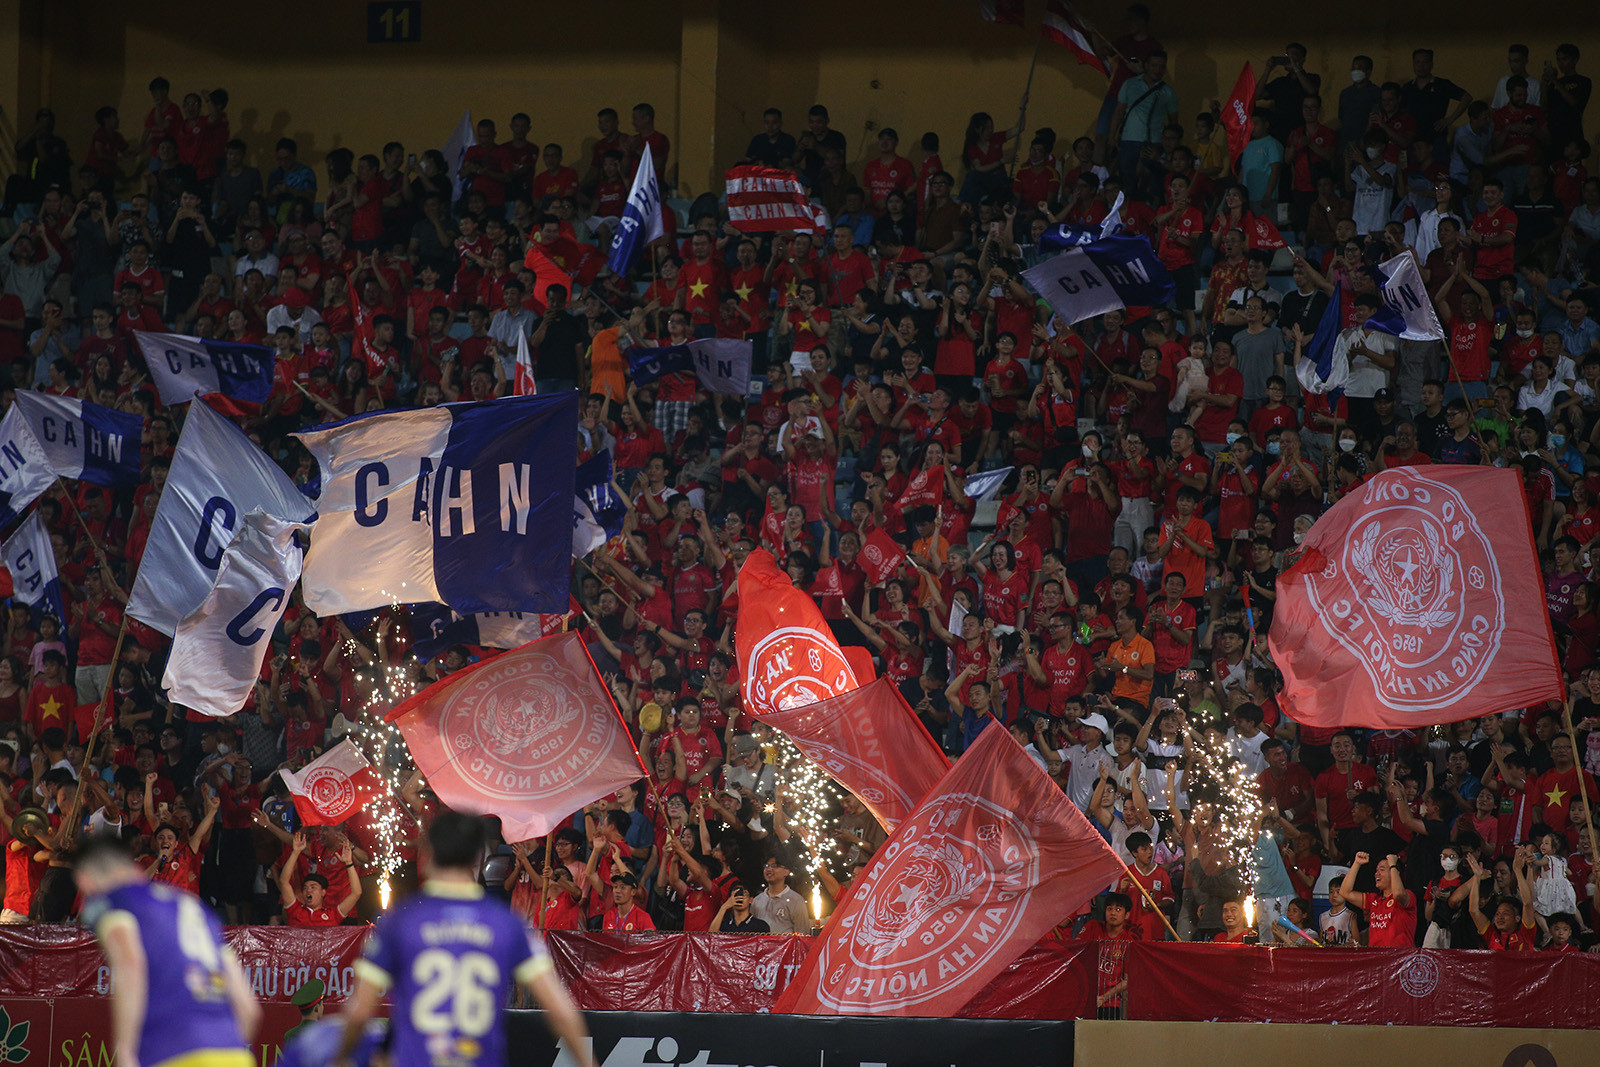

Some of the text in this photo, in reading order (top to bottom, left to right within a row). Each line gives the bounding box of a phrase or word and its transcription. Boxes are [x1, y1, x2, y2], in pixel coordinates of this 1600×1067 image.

[379, 7, 409, 38] 11
[741, 177, 778, 193] CAHN
[743, 203, 786, 220] CAHN
[1058, 257, 1151, 294] CAHN
[165, 349, 261, 375] CAHN
[43, 417, 123, 463] CAHN
[354, 457, 531, 537] CAHN
[226, 587, 286, 647] C
[766, 650, 791, 685] AN
[411, 948, 499, 1037] 26
[783, 964, 801, 991] T
